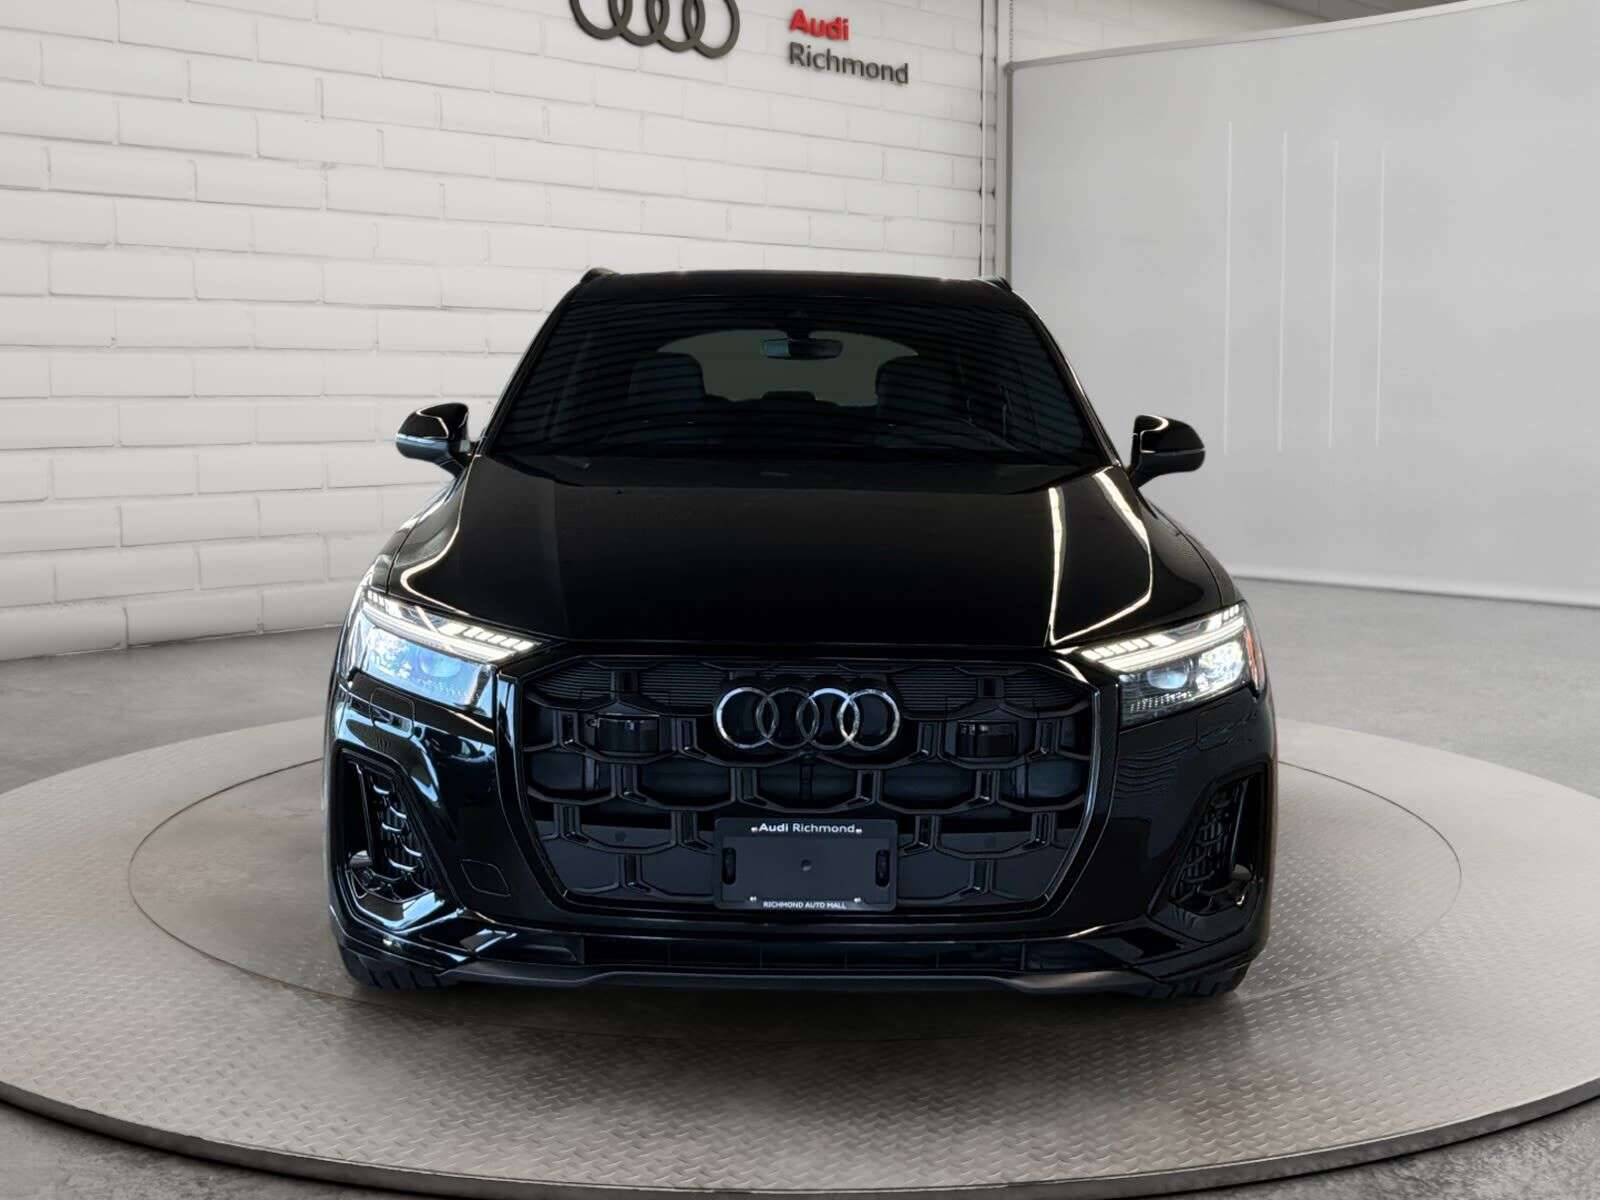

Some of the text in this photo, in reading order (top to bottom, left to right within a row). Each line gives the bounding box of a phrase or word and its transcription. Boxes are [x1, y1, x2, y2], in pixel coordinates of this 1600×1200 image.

[789, 9, 850, 41] Audi
[789, 42, 909, 85] Richmond
[759, 823, 856, 834] Audi Richmond
[763, 901, 804, 909] RICHMOND
